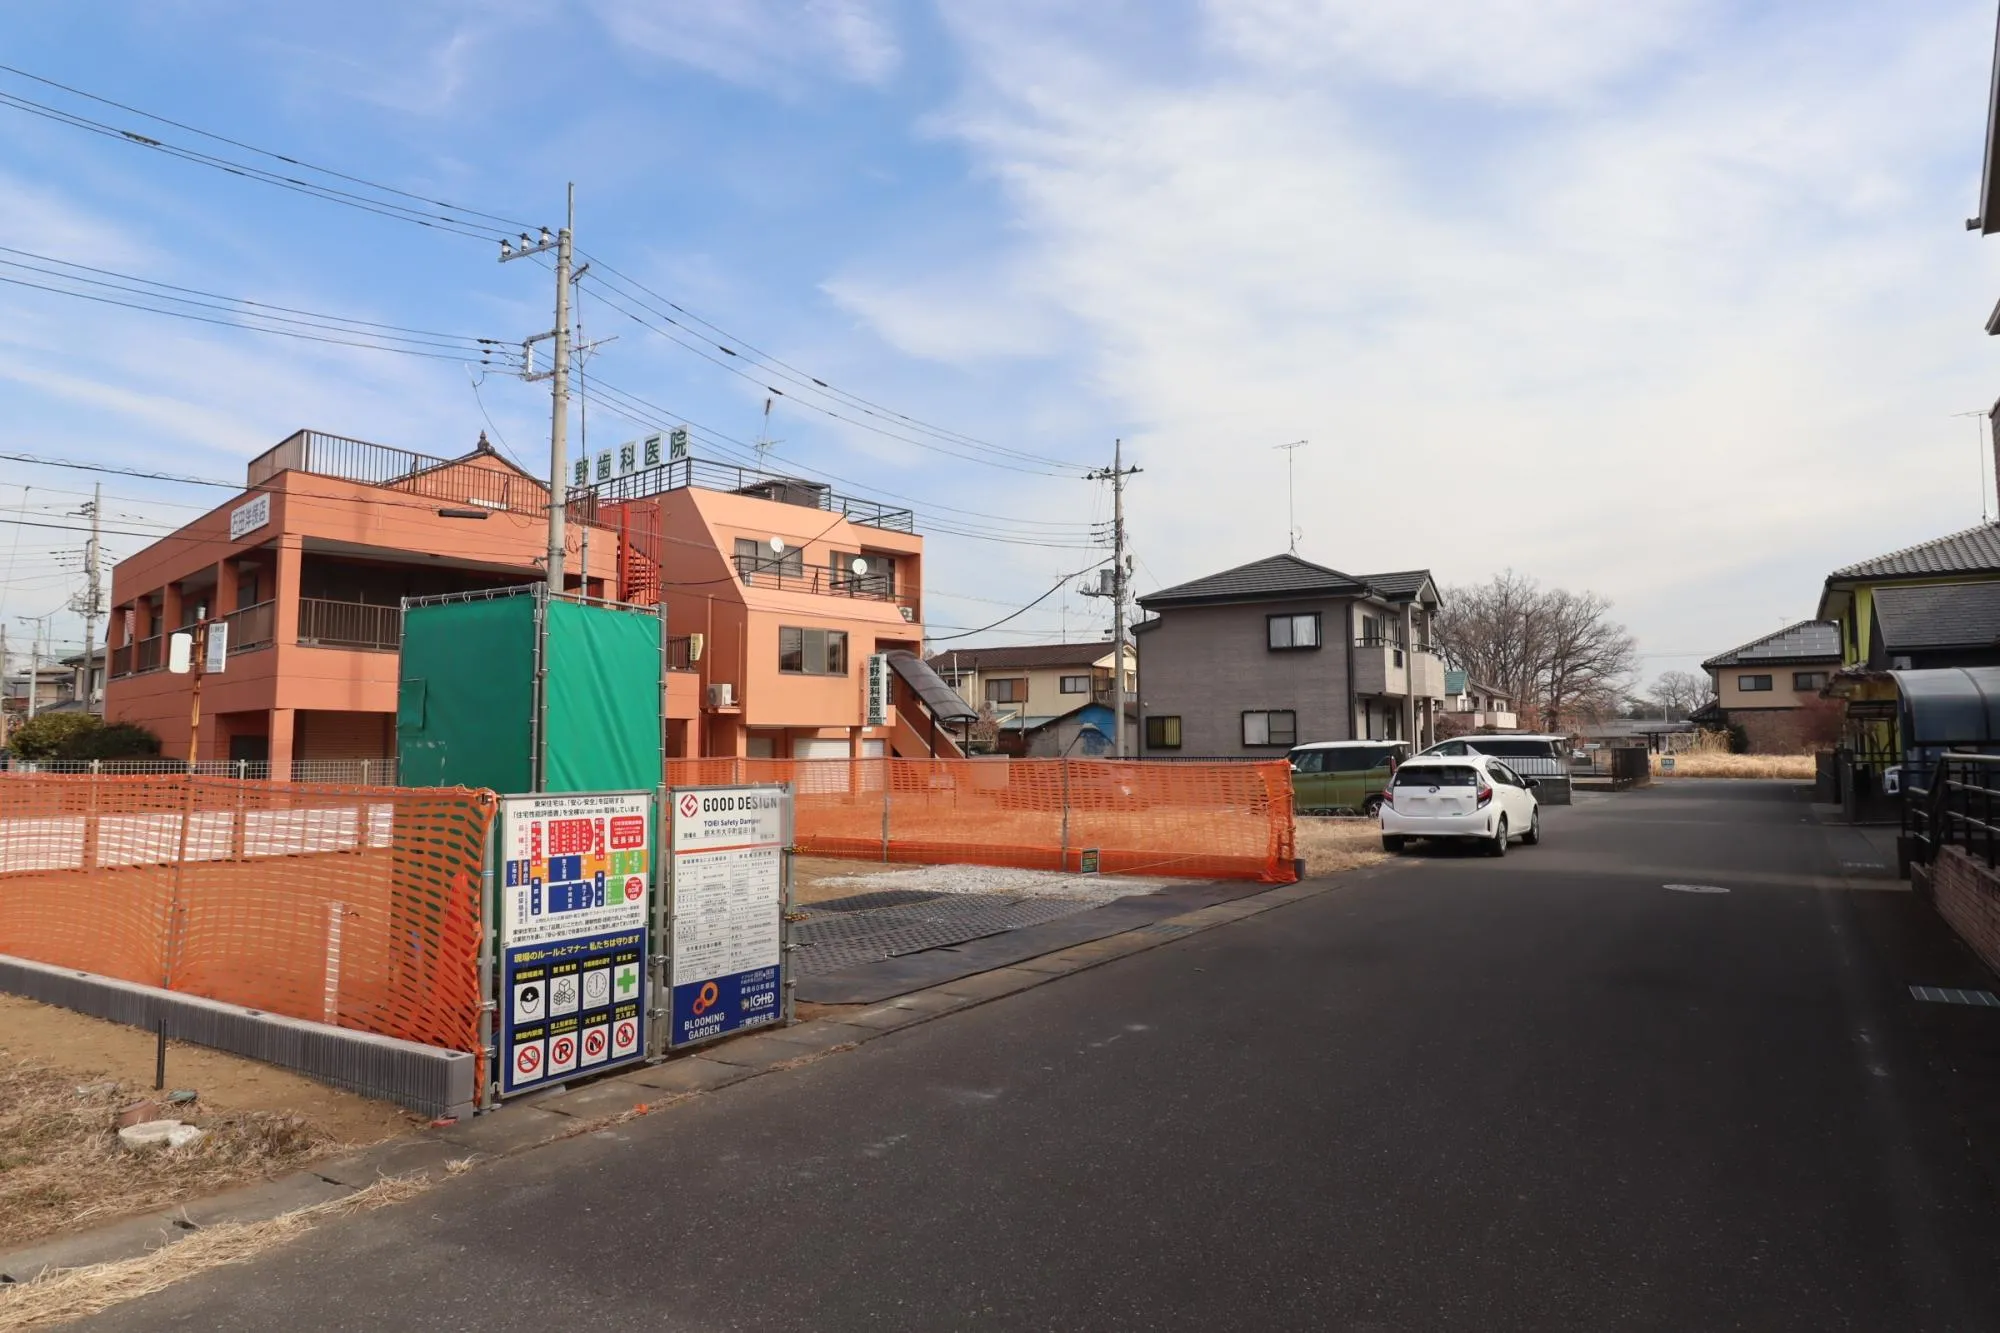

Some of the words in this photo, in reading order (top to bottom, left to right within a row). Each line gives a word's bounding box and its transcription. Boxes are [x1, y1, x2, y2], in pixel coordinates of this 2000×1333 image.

[567, 430, 687, 487] 野歯科医院
[703, 797, 734, 813] GOOD
[738, 796, 777, 811] DESIGN
[720, 818, 739, 828] Safety
[513, 944, 588, 963] 現場のルールとマナー
[589, 934, 641, 951] 私たちは守ります
[684, 1012, 725, 1031] BLOOMING
[688, 1024, 720, 1040] GARDEN
